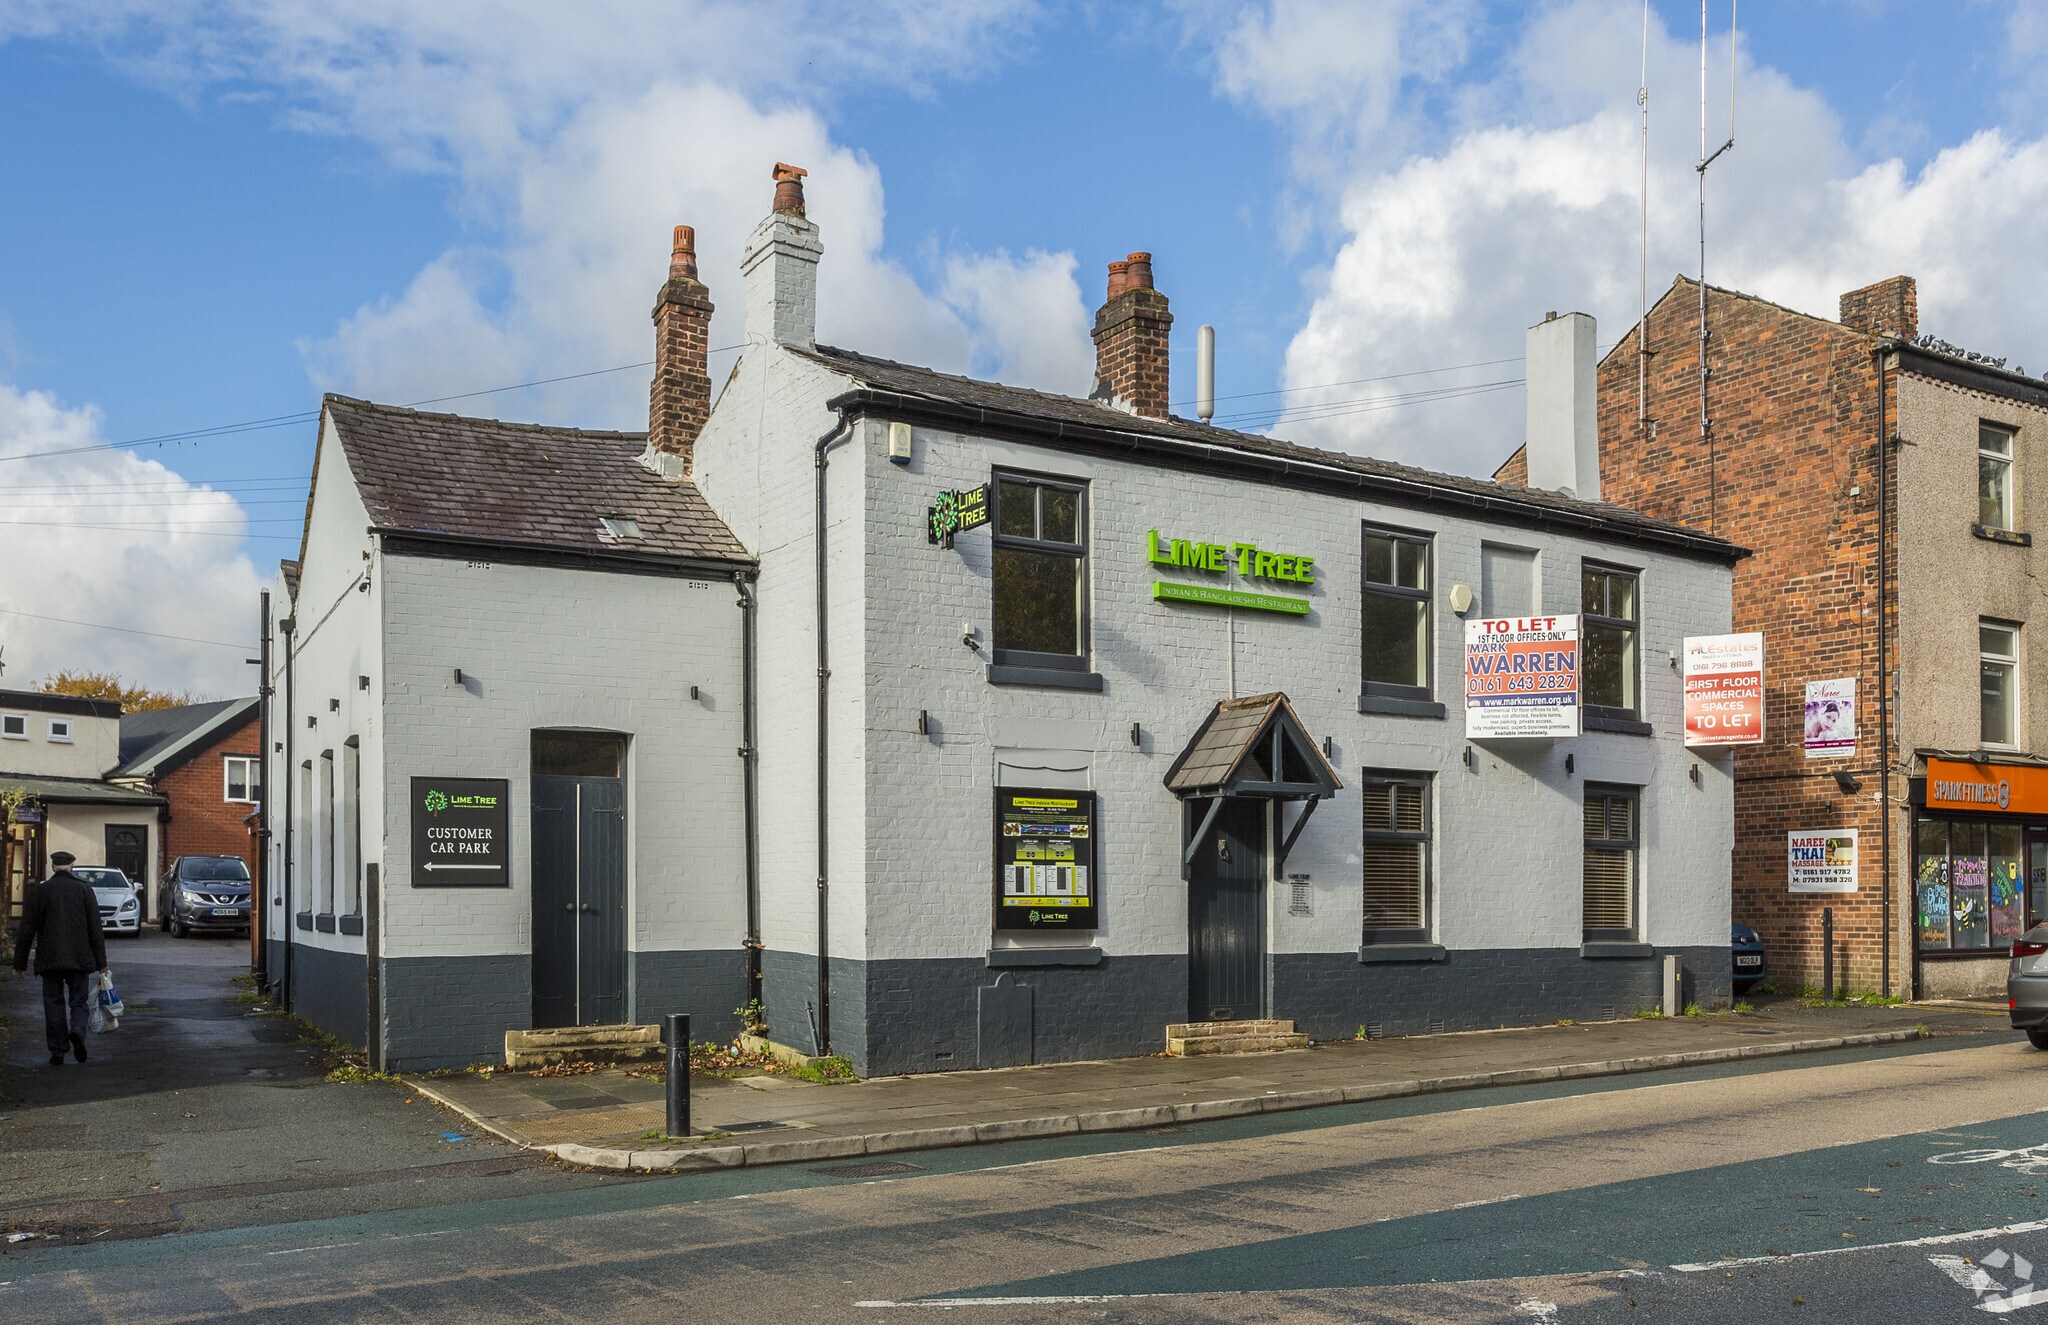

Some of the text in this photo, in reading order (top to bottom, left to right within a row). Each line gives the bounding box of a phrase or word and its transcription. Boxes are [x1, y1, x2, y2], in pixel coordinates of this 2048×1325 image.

[958, 488, 983, 510] LIME
[958, 506, 986, 527] TREE
[1148, 529, 1315, 584] LIME TREE
[1162, 585, 1307, 611] INDIAN & BANGLADESHI RESTAURANT
[1482, 617, 1556, 634] TO LET
[1478, 631, 1567, 643] 1ST FLOOR OFFICES ONLY
[1469, 643, 1507, 654] MARK
[1469, 652, 1575, 675] WARREN
[1730, 660, 1753, 668] 8888
[1469, 674, 1574, 692] 0161 643 2827
[1687, 677, 1758, 689] FIRST FLOOR
[1483, 695, 1572, 707] www.markwarren.org.uk
[1687, 689, 1759, 701] COMMERCIAL
[1701, 701, 1744, 712] SPACES
[1694, 713, 1752, 728] TO LET
[451, 795, 497, 805] LIME TREE
[427, 827, 493, 839] CUSTOMER
[430, 842, 490, 854] CAR PARK
[1791, 838, 1825, 847] NAREE
[1791, 847, 1825, 860] THAI
